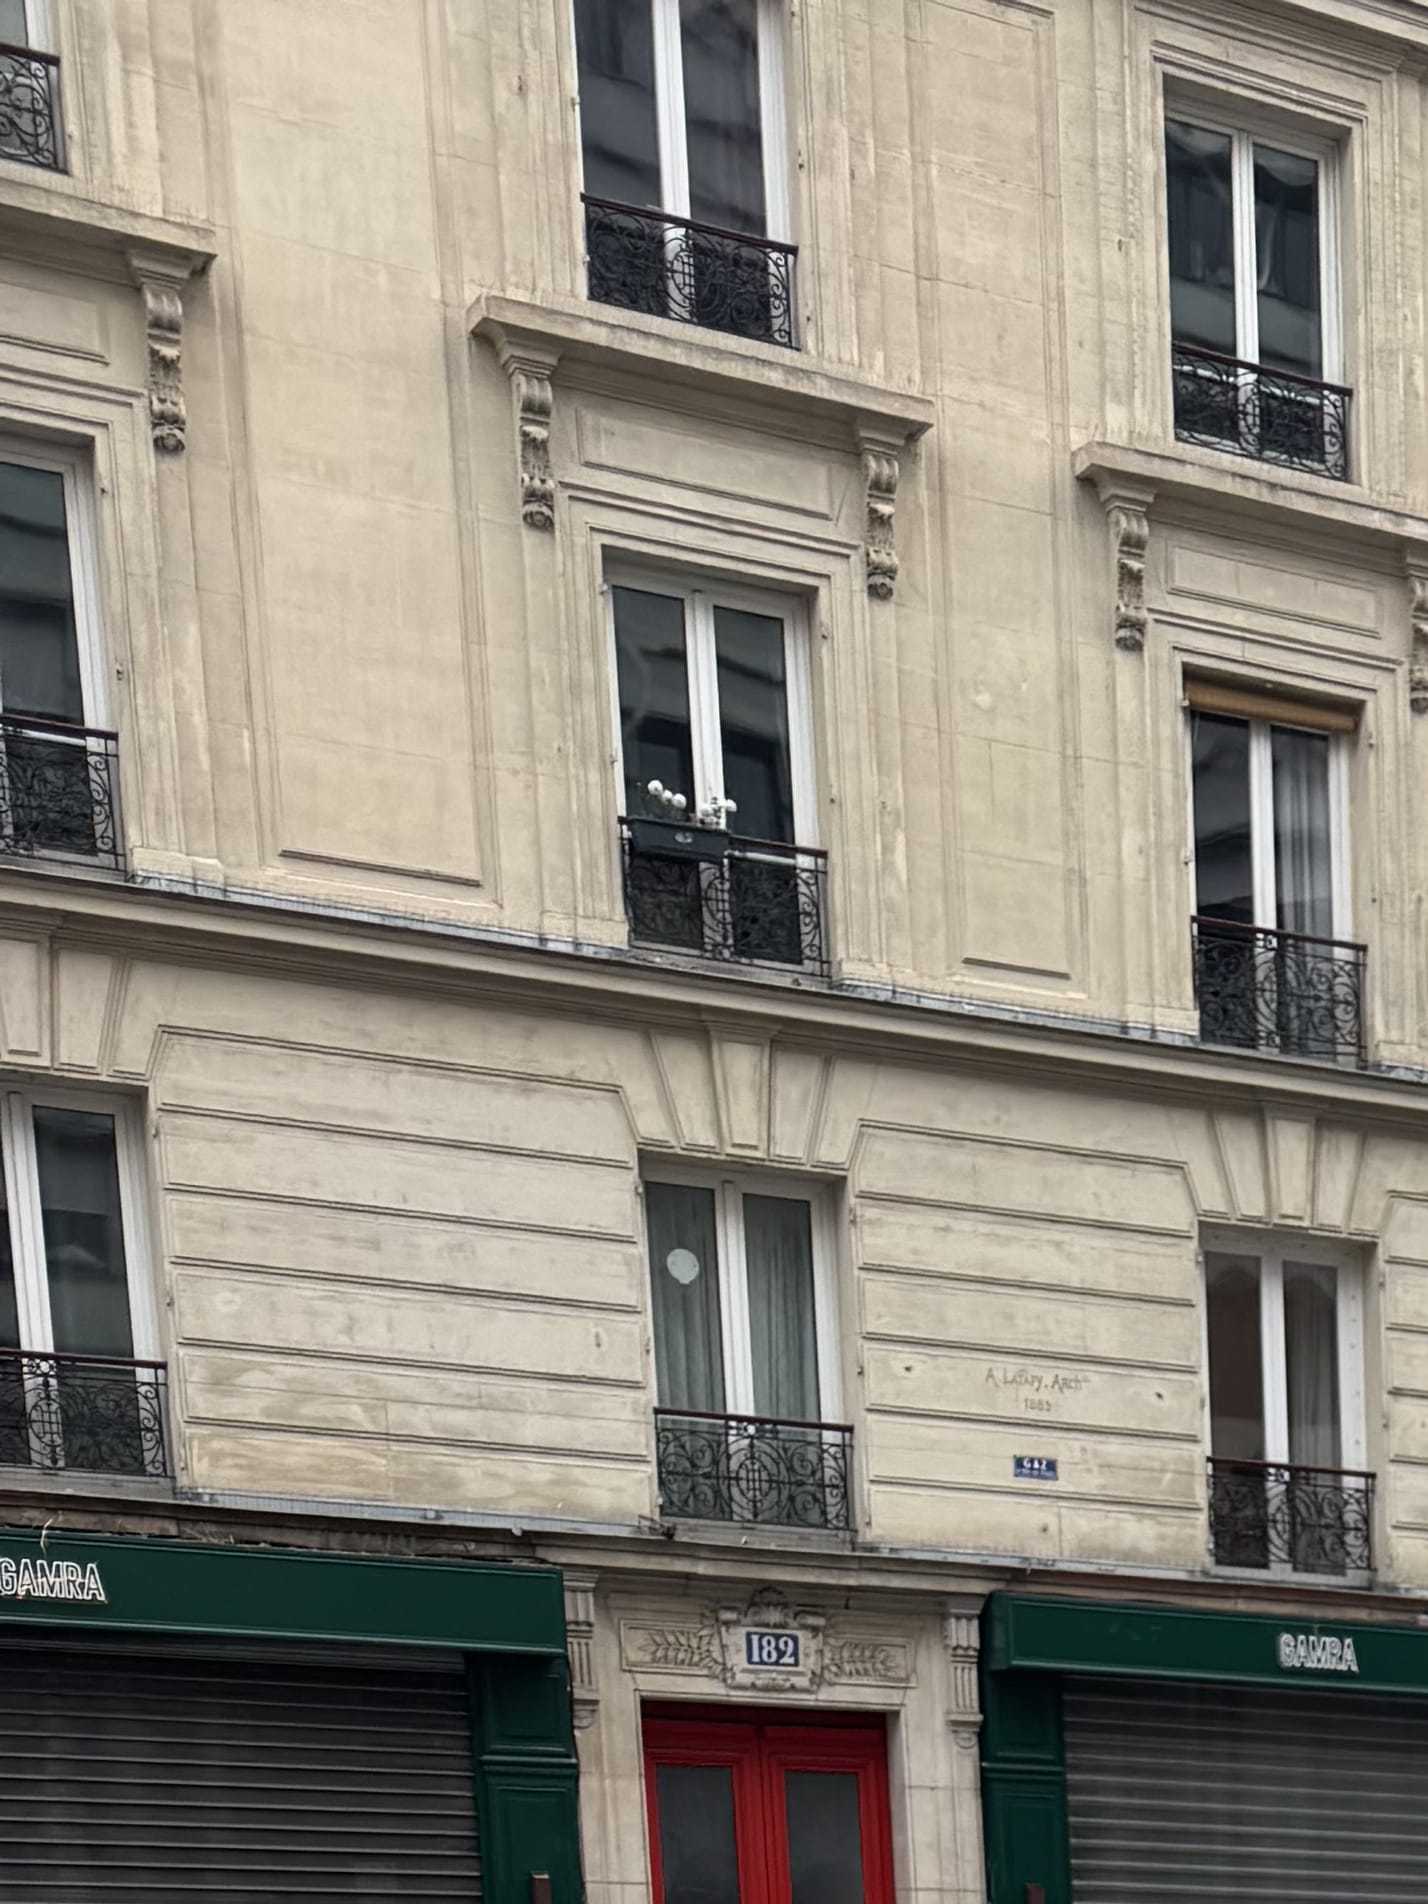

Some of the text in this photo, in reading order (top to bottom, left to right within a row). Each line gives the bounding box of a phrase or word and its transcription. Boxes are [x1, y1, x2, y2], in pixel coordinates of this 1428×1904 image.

[0, 1557, 106, 1602] GAMRA
[750, 1633, 795, 1664] 182
[1279, 1632, 1359, 1673] GAMRA
